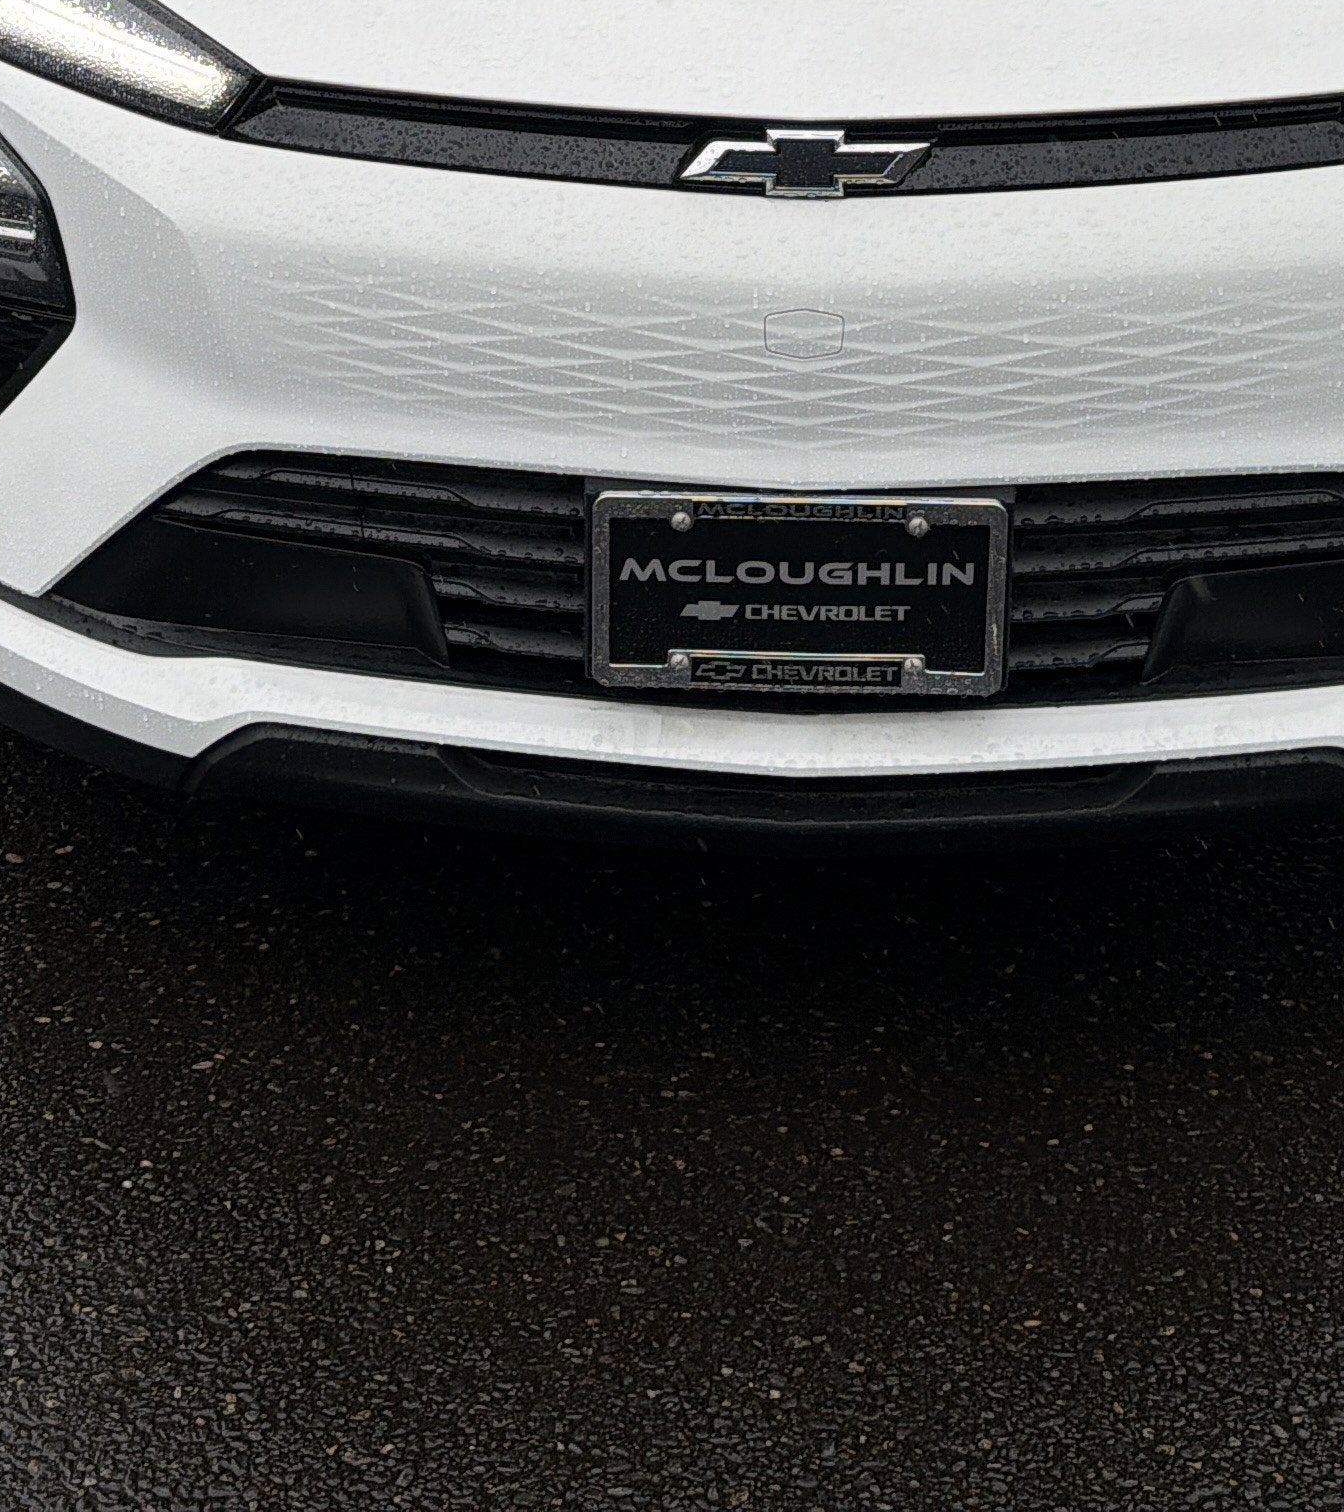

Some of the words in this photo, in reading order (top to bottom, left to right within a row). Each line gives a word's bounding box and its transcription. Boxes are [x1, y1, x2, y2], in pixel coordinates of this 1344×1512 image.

[696, 502, 904, 520] MCLOUGHLIN
[619, 557, 975, 586] MCLOUGHLIN
[744, 604, 912, 622] CHEVROLET
[750, 662, 898, 683] CHEVROLET
